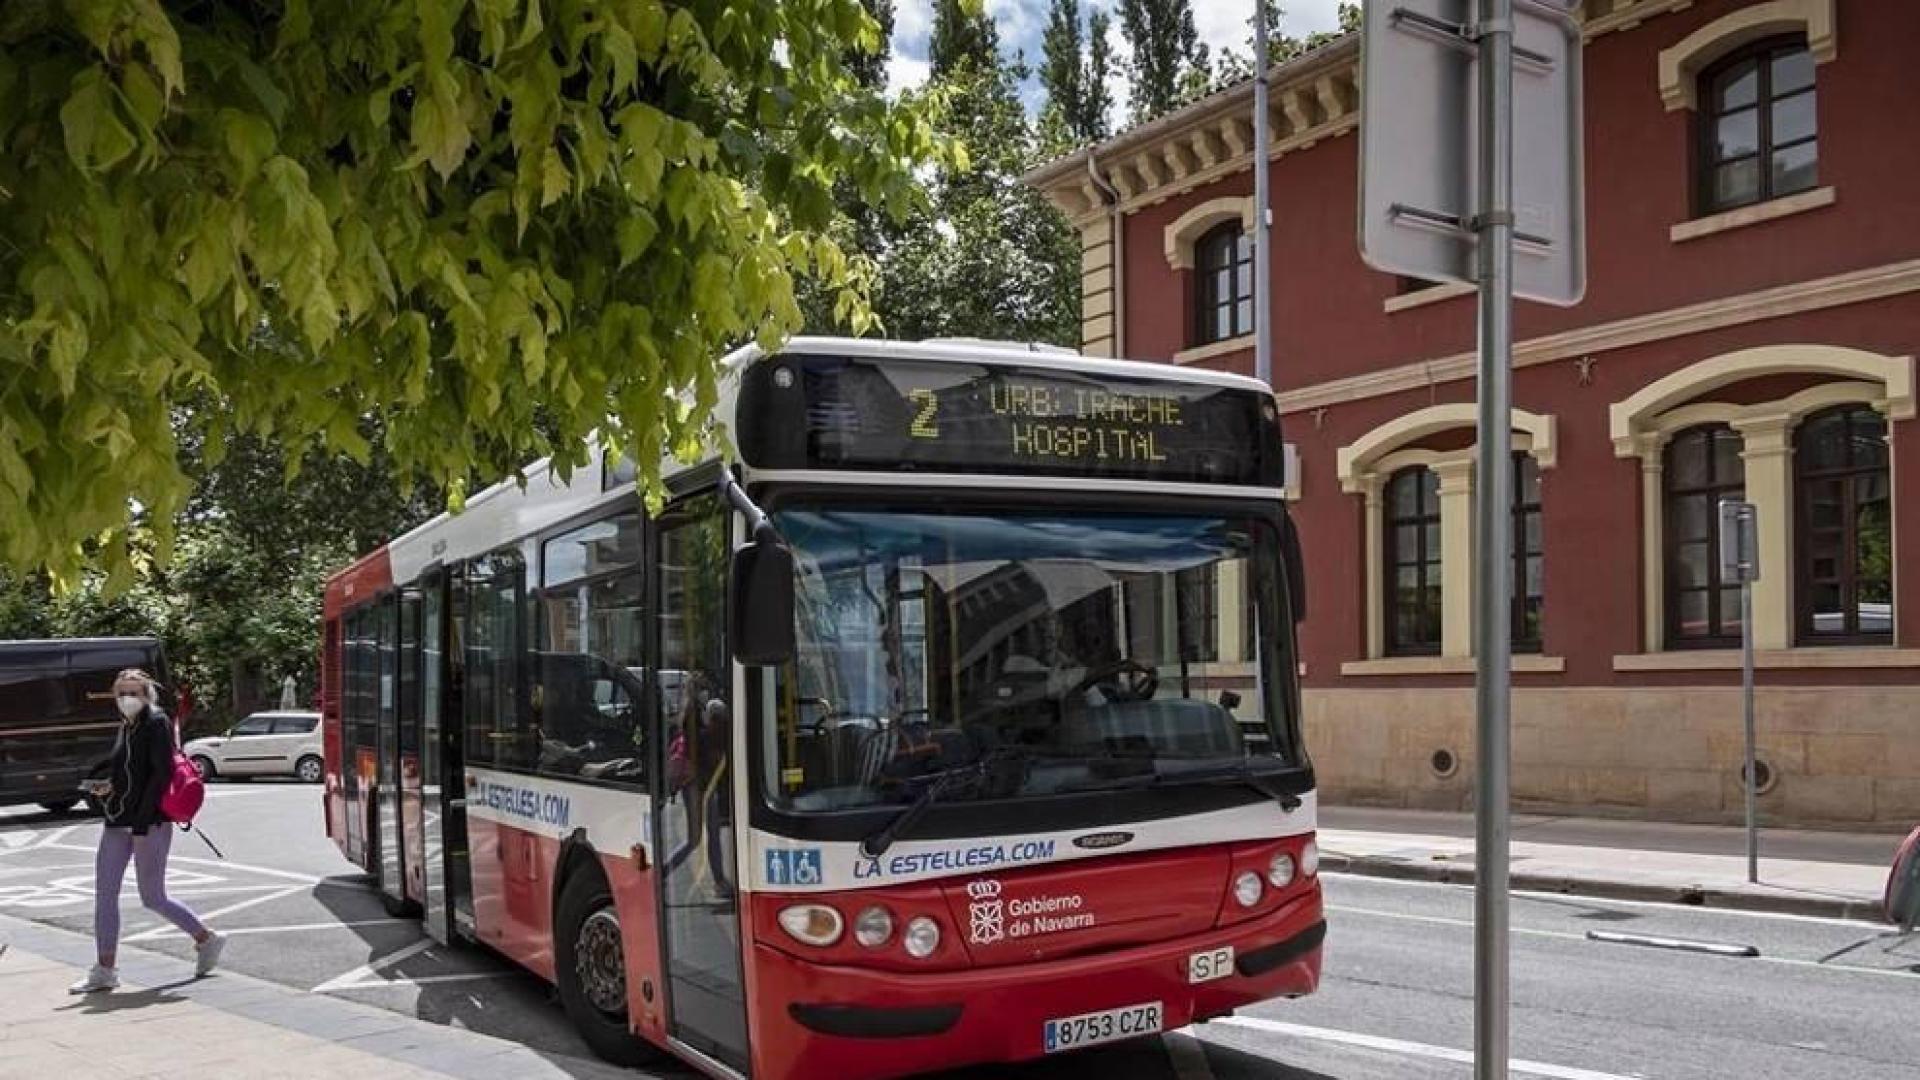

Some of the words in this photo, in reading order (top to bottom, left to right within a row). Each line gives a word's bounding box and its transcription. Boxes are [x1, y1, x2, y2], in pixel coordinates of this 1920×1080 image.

[908, 388, 940, 438] 2
[1076, 389, 1184, 426] IRACHE
[1013, 423, 1167, 461] HOSPITAL
[853, 858, 882, 879] LA
[890, 840, 1055, 875] ESTELLESA.COM
[1008, 894, 1082, 916] Gobierno
[1009, 919, 1031, 938] de
[1035, 912, 1095, 934] Navarra
[1059, 1014, 1113, 1044] 8753
[1120, 1006, 1158, 1034] CZR
